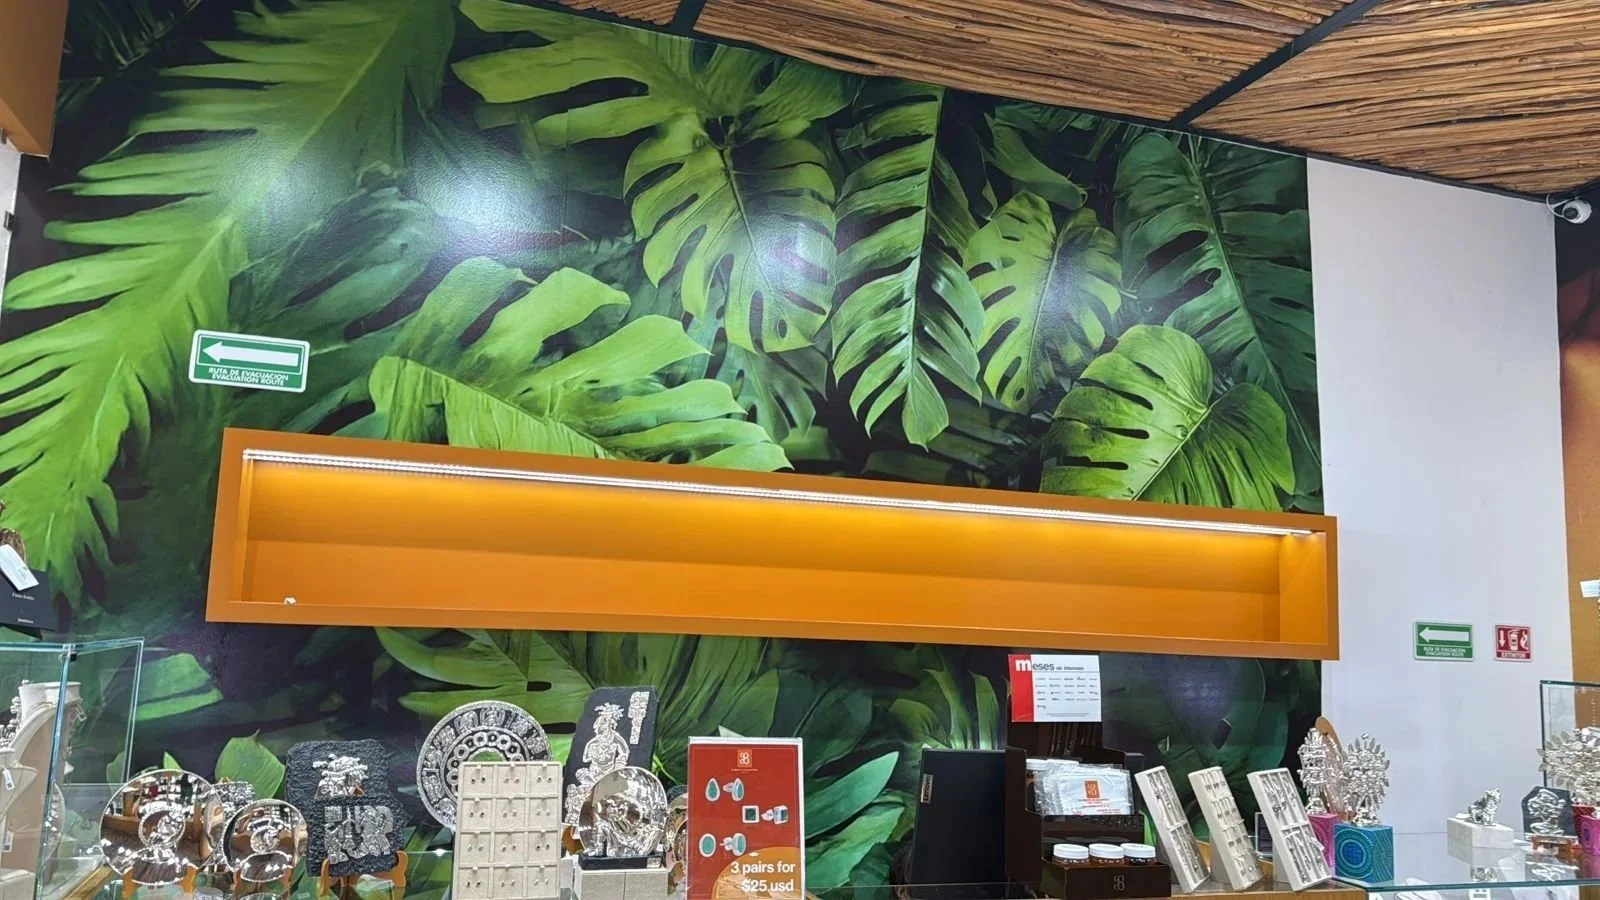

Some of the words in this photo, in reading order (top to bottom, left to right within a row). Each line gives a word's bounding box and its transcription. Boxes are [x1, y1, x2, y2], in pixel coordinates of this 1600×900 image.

[208, 367, 228, 375] RUTA
[212, 373, 259, 384] EVACUATION
[260, 378, 285, 386] ROUTE
[1015, 659, 1055, 671] meses
[923, 776, 931, 801] Lenovo
[730, 861, 740, 874] 3
[742, 861, 775, 876] pairs
[776, 861, 796, 873] for
[741, 878, 768, 893] $25
[769, 879, 794, 892] usd
